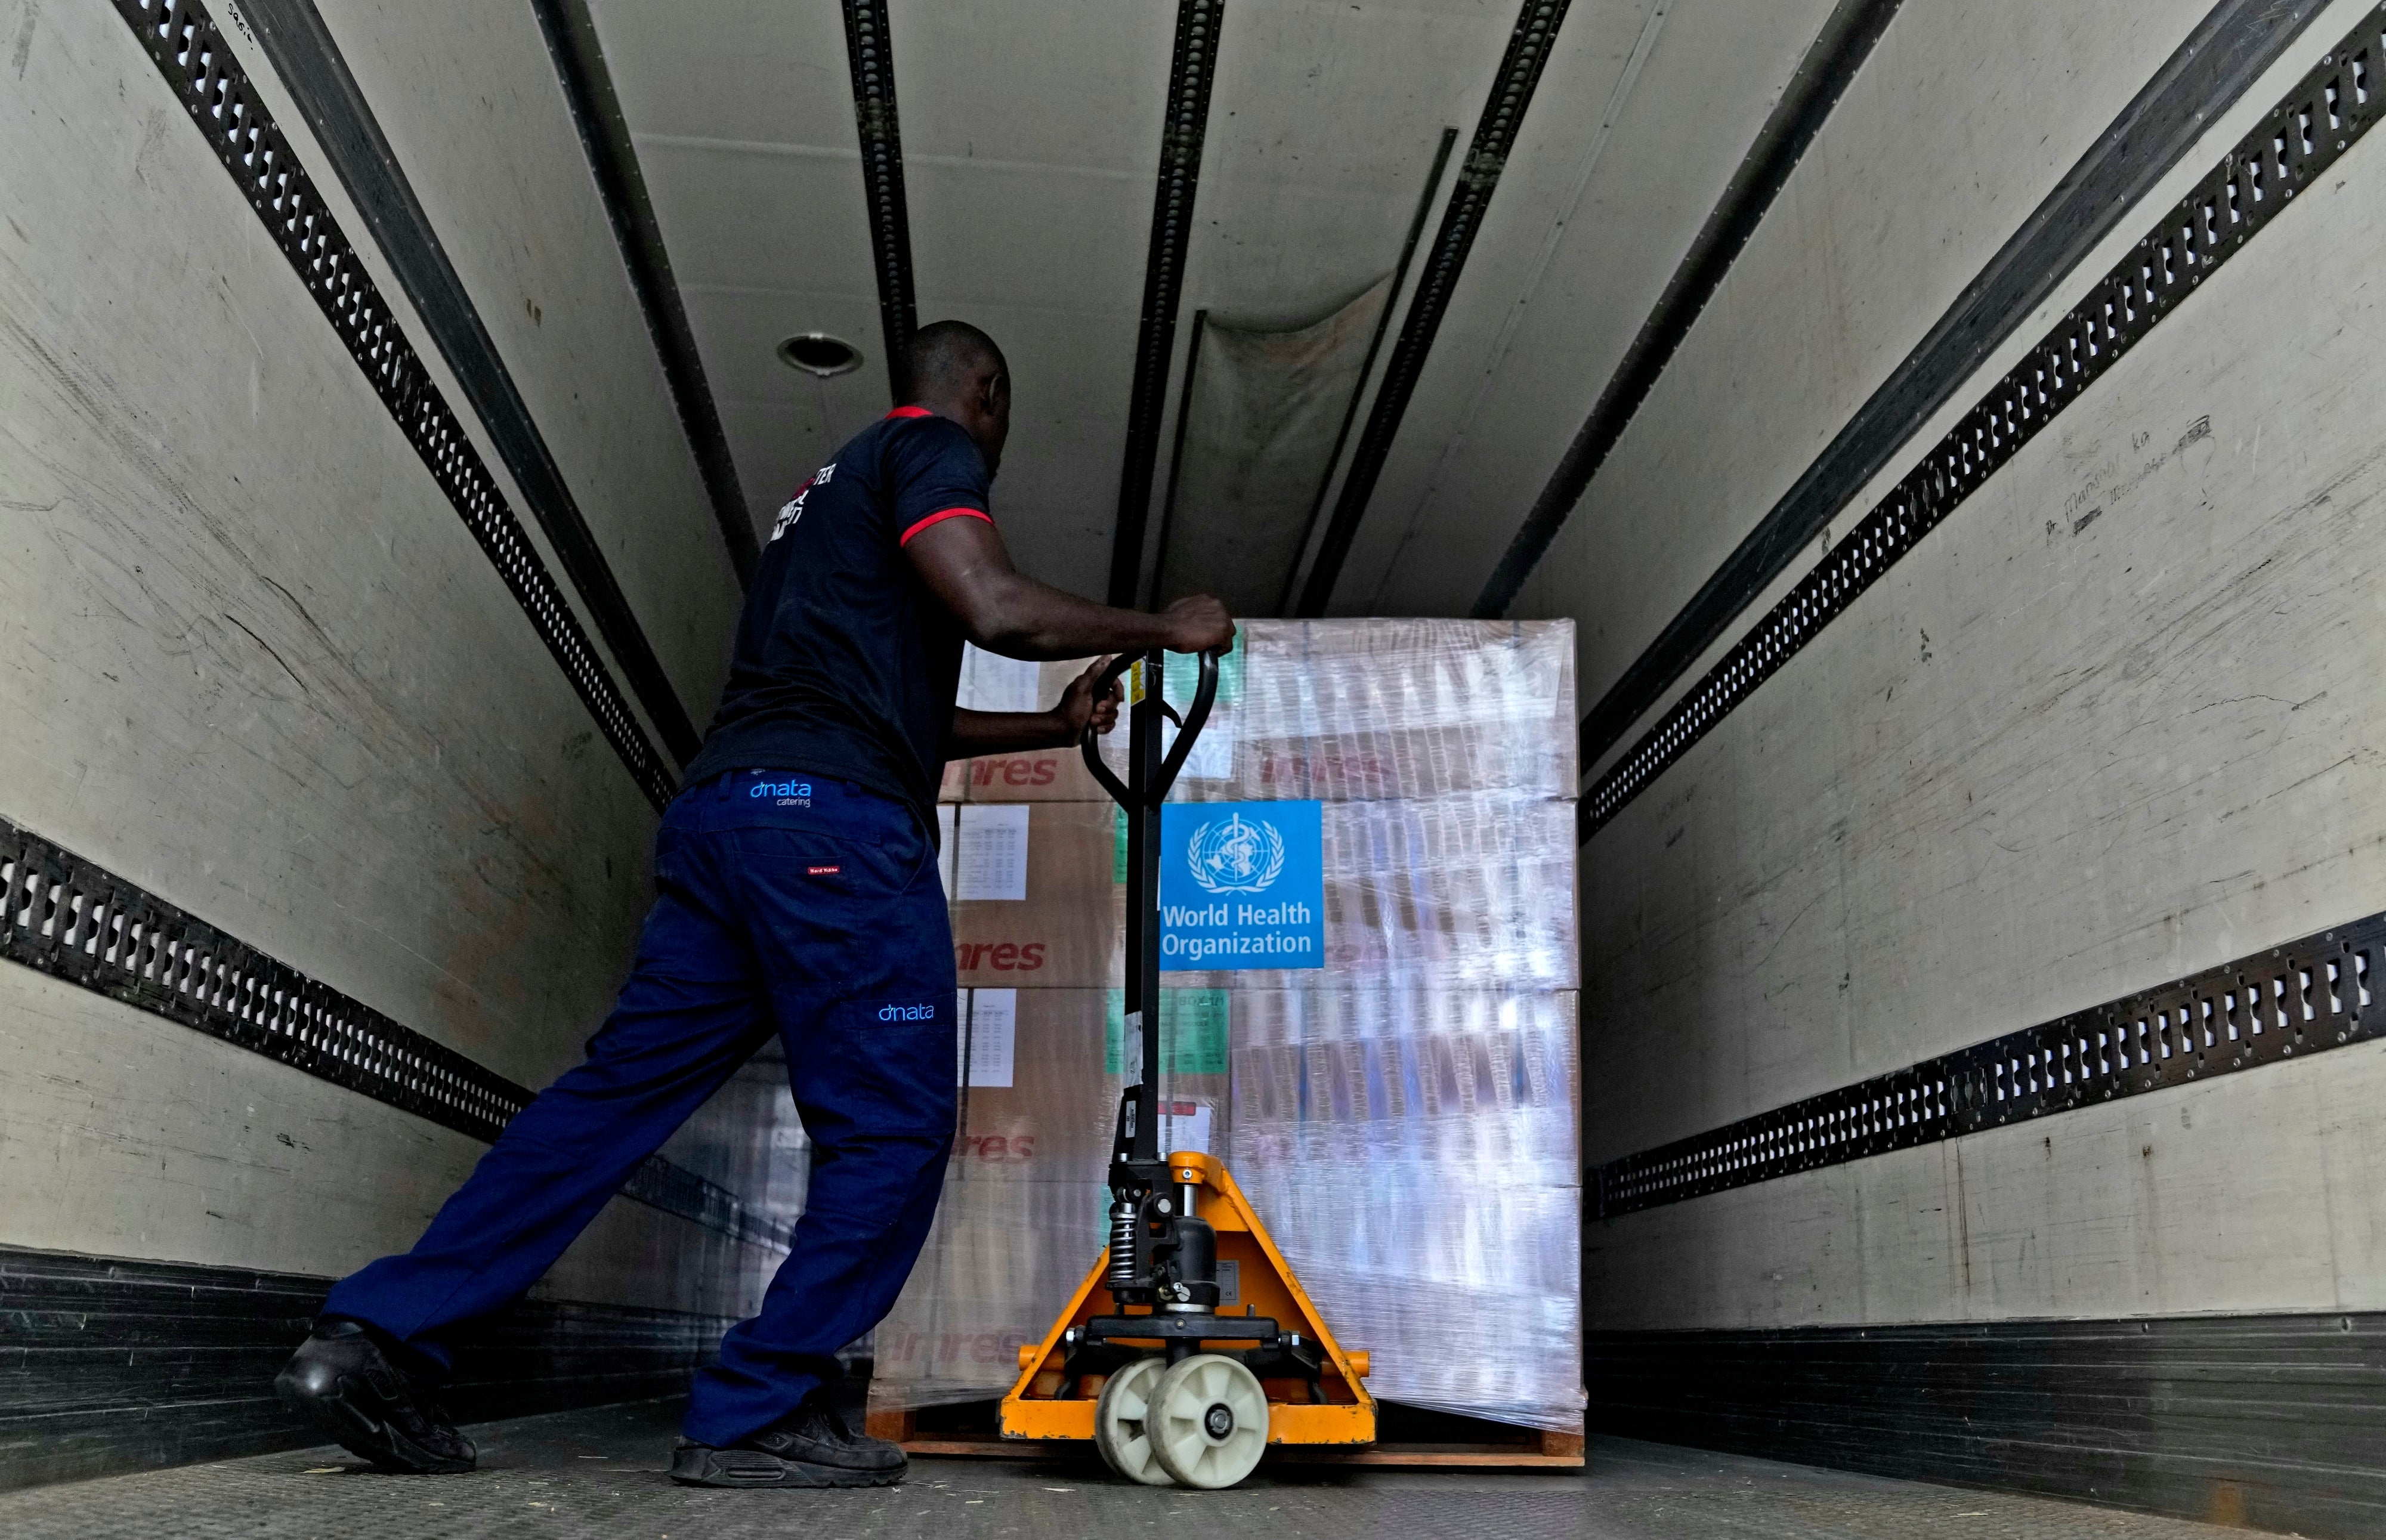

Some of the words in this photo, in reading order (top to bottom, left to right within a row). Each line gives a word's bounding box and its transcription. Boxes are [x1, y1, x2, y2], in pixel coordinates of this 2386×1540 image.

[750, 780, 812, 797] dnata
[777, 797, 811, 808] catering
[1163, 903, 1228, 927] World
[1238, 902, 1311, 925] Health
[1163, 931, 1311, 961] Organization
[879, 1003, 934, 1021] dnata
